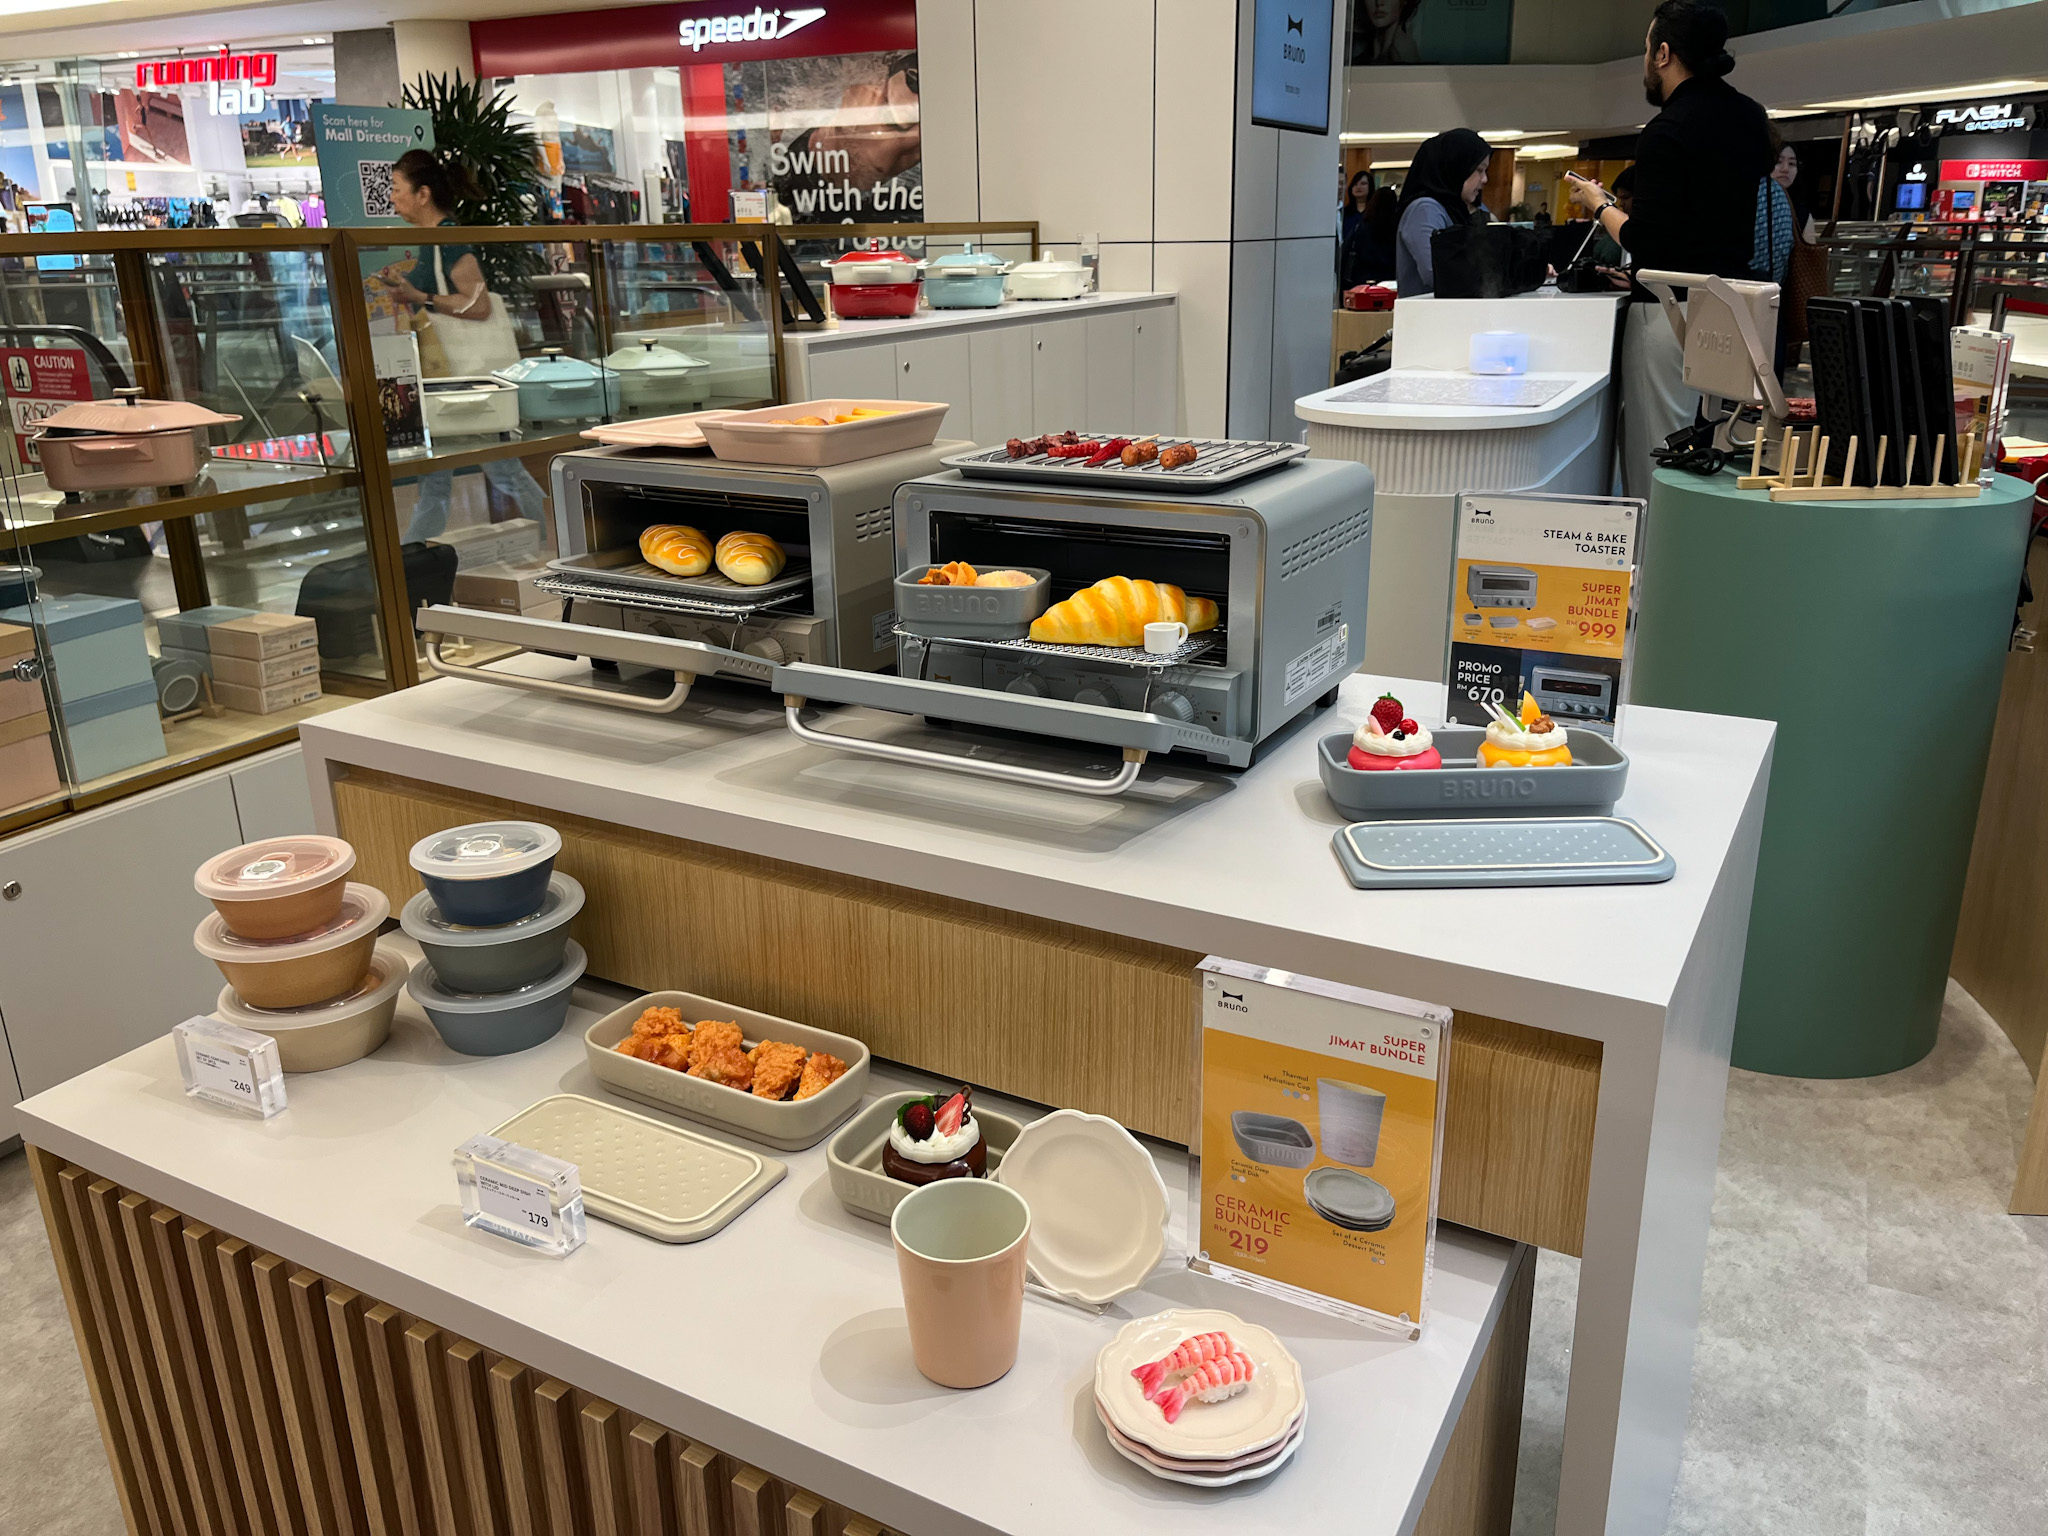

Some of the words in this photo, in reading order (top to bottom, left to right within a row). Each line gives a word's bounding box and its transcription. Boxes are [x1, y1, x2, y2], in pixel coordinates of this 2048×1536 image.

[679, 6, 779, 52] speedo
[1283, 43, 1306, 64] BRUNO
[136, 48, 276, 88] running
[209, 79, 265, 116] lab
[322, 114, 345, 126] Scan
[348, 115, 368, 128] here
[371, 116, 384, 128] for
[1935, 103, 2013, 124] FLASH
[1964, 117, 2025, 131] GADGETS
[325, 128, 353, 142] Mall
[356, 129, 413, 148] Directory
[771, 141, 850, 176] Swim
[1980, 169, 2022, 178] SWITCH
[792, 178, 862, 213] with
[871, 176, 923, 212] the
[34, 355, 75, 370] CAUTION
[1471, 517, 1495, 525] BRUNO
[1543, 530, 1582, 541] STEAM
[1585, 533, 1593, 541] &
[1597, 533, 1627, 544] BAKE
[1575, 544, 1626, 556] TOASTER
[1581, 583, 1621, 595] SUPER
[1584, 595, 1621, 607] JIMAT
[1568, 606, 1619, 619] BUNDLE
[1578, 621, 1617, 639] 999
[1458, 661, 1502, 674] PROMO
[1457, 672, 1491, 685] PRICE
[1468, 686, 1505, 704] 670
[1442, 778, 1537, 799] BRUNO
[1217, 1000, 1248, 1013] BRUNO
[1328, 1035, 1366, 1051] JIMAT
[1370, 1045, 1426, 1066] BUNDLE
[1384, 1035, 1426, 1053] SUPER
[1263, 1074, 1296, 1087] Hydration
[1297, 1082, 1311, 1091] Cup
[1282, 1070, 1309, 1082] Thermal
[234, 1080, 251, 1093] 249
[1257, 1143, 1304, 1161] BRUNO
[1231, 1159, 1253, 1171] Ceramic
[1248, 1170, 1260, 1178] Dish
[1215, 1194, 1291, 1225] CERAMIC
[528, 1212, 548, 1227] 179
[1215, 1207, 1283, 1237] BUNDLE
[1214, 1224, 1227, 1233] RM
[1229, 1230, 1269, 1255] 219
[1332, 1229, 1342, 1237] Set
[1359, 1238, 1386, 1250] Ceramic
[1343, 1240, 1367, 1252] Dessert
[1369, 1247, 1386, 1257] Plate
